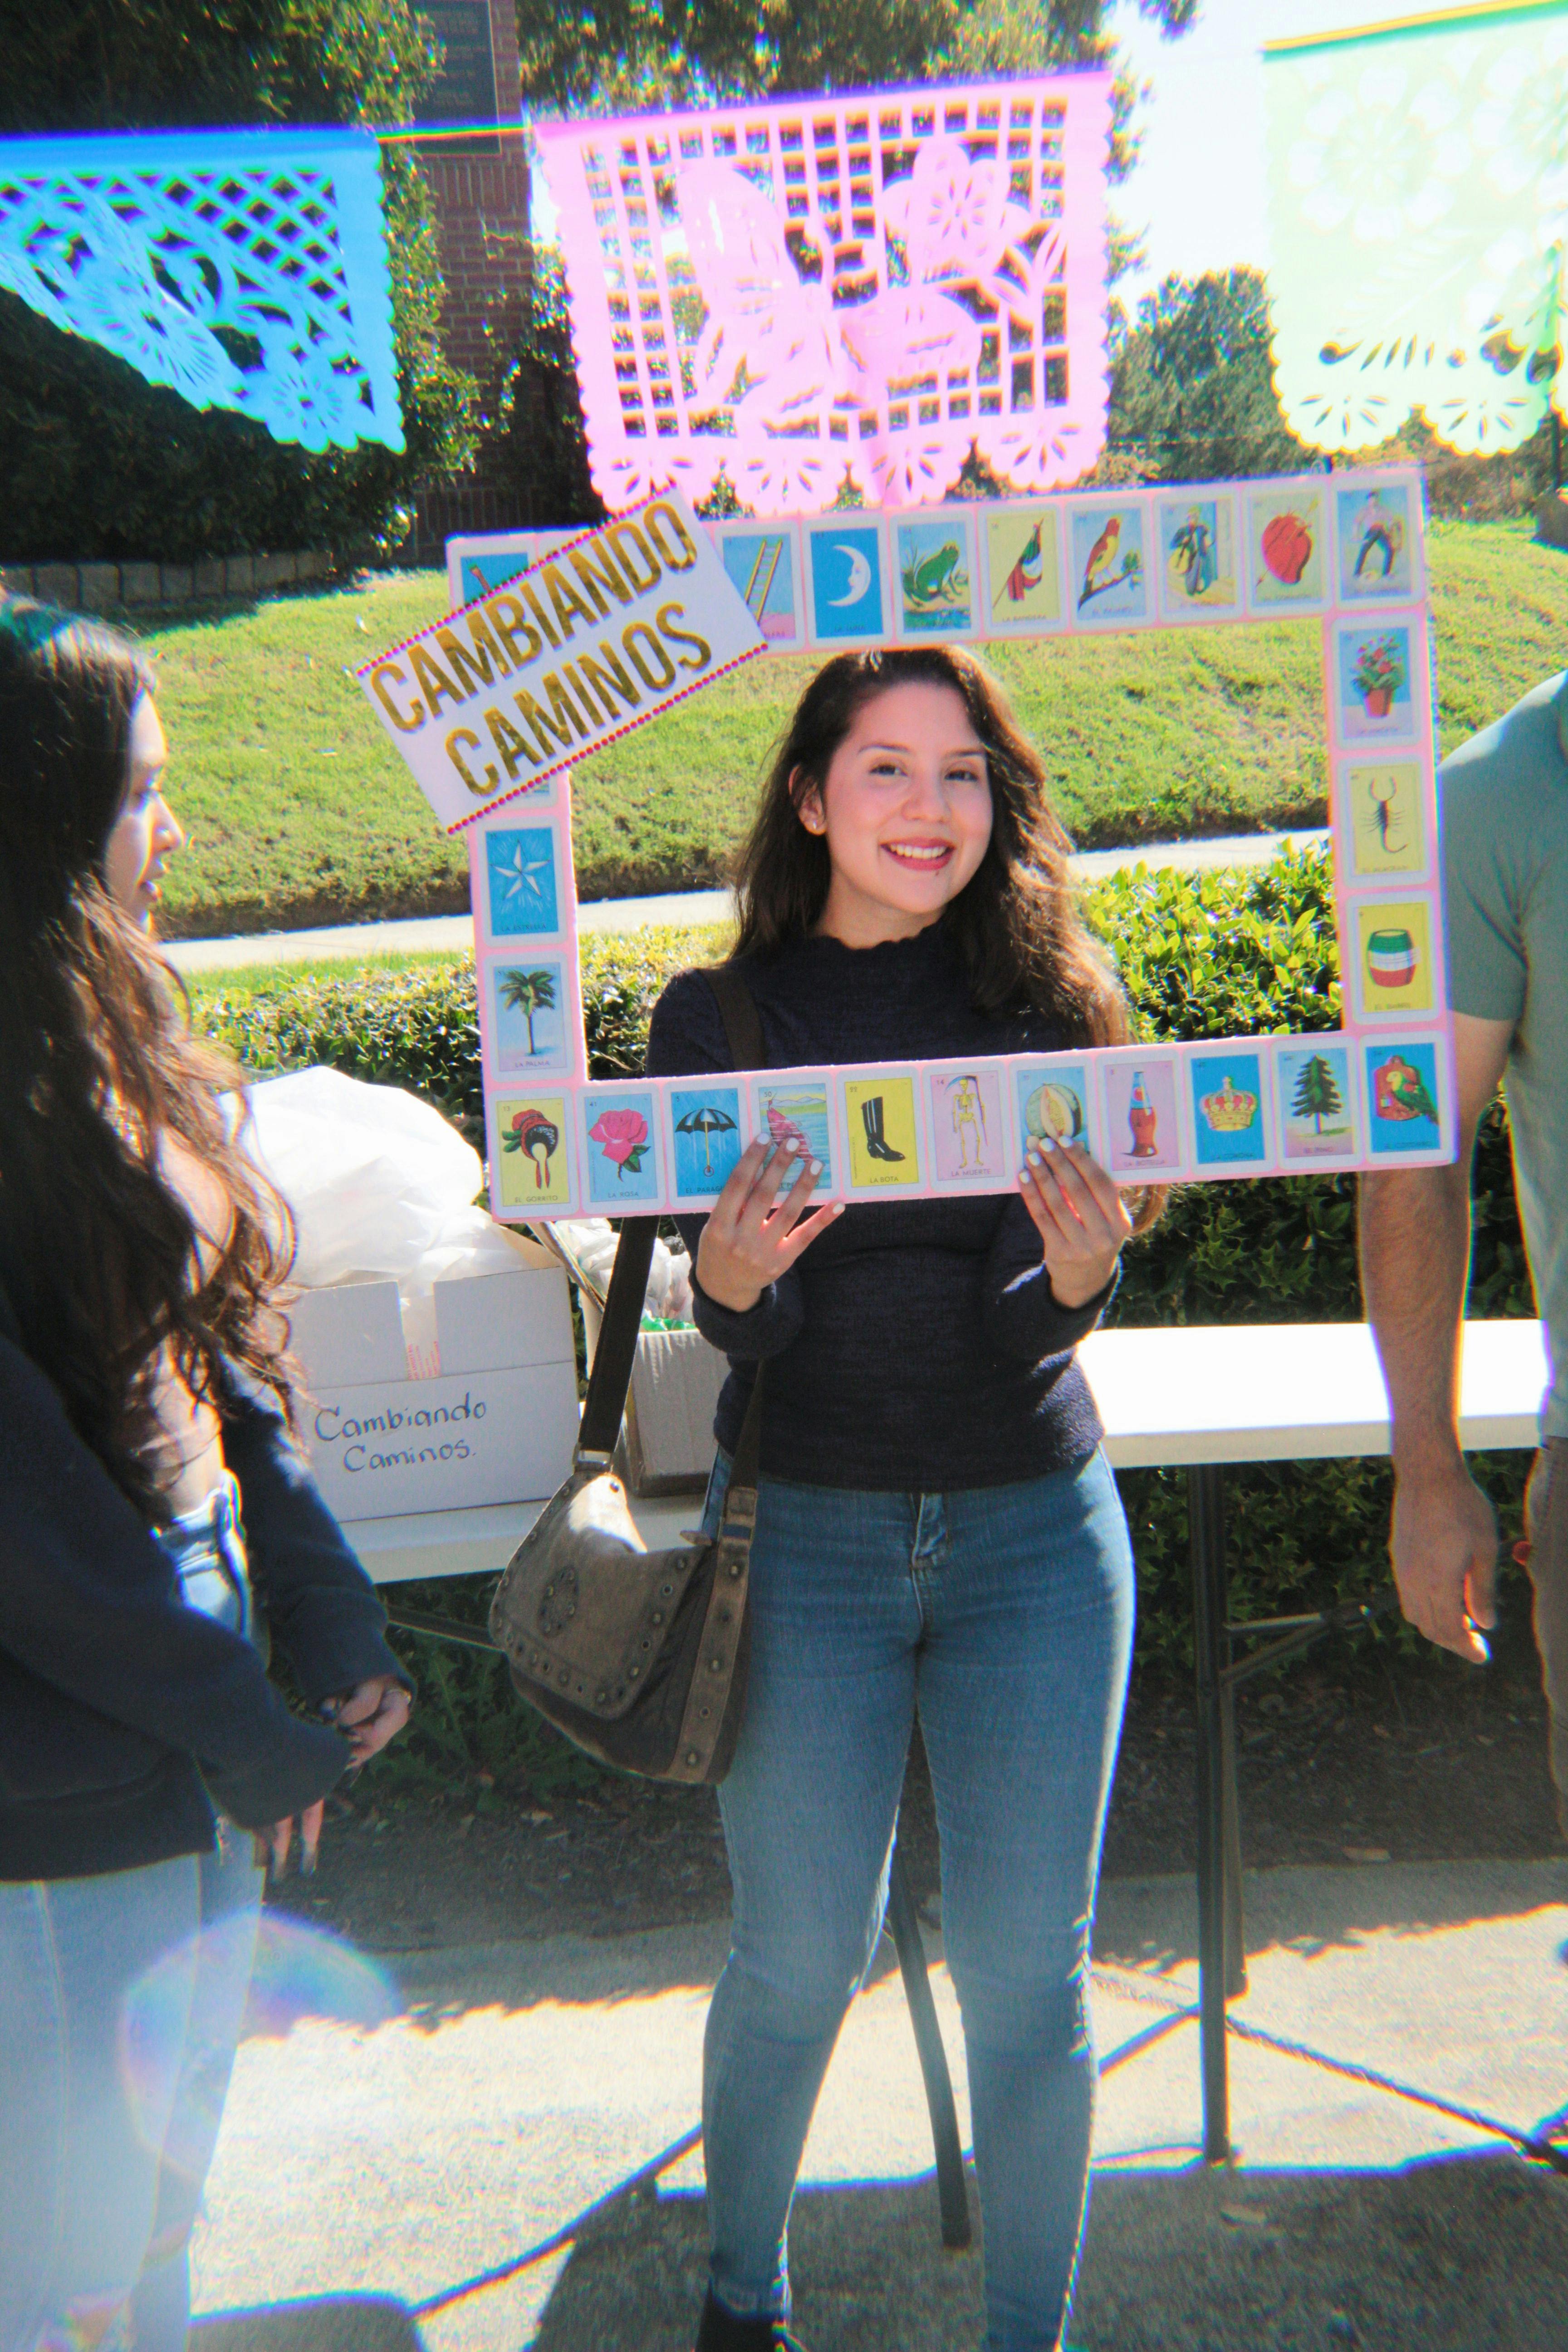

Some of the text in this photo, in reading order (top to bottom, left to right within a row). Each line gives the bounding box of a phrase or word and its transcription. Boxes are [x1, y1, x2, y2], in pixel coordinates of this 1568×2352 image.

[371, 501, 697, 731] CAMBIANDO
[445, 602, 712, 797] CAMINOS
[315, 1392, 486, 1441] Cambiando
